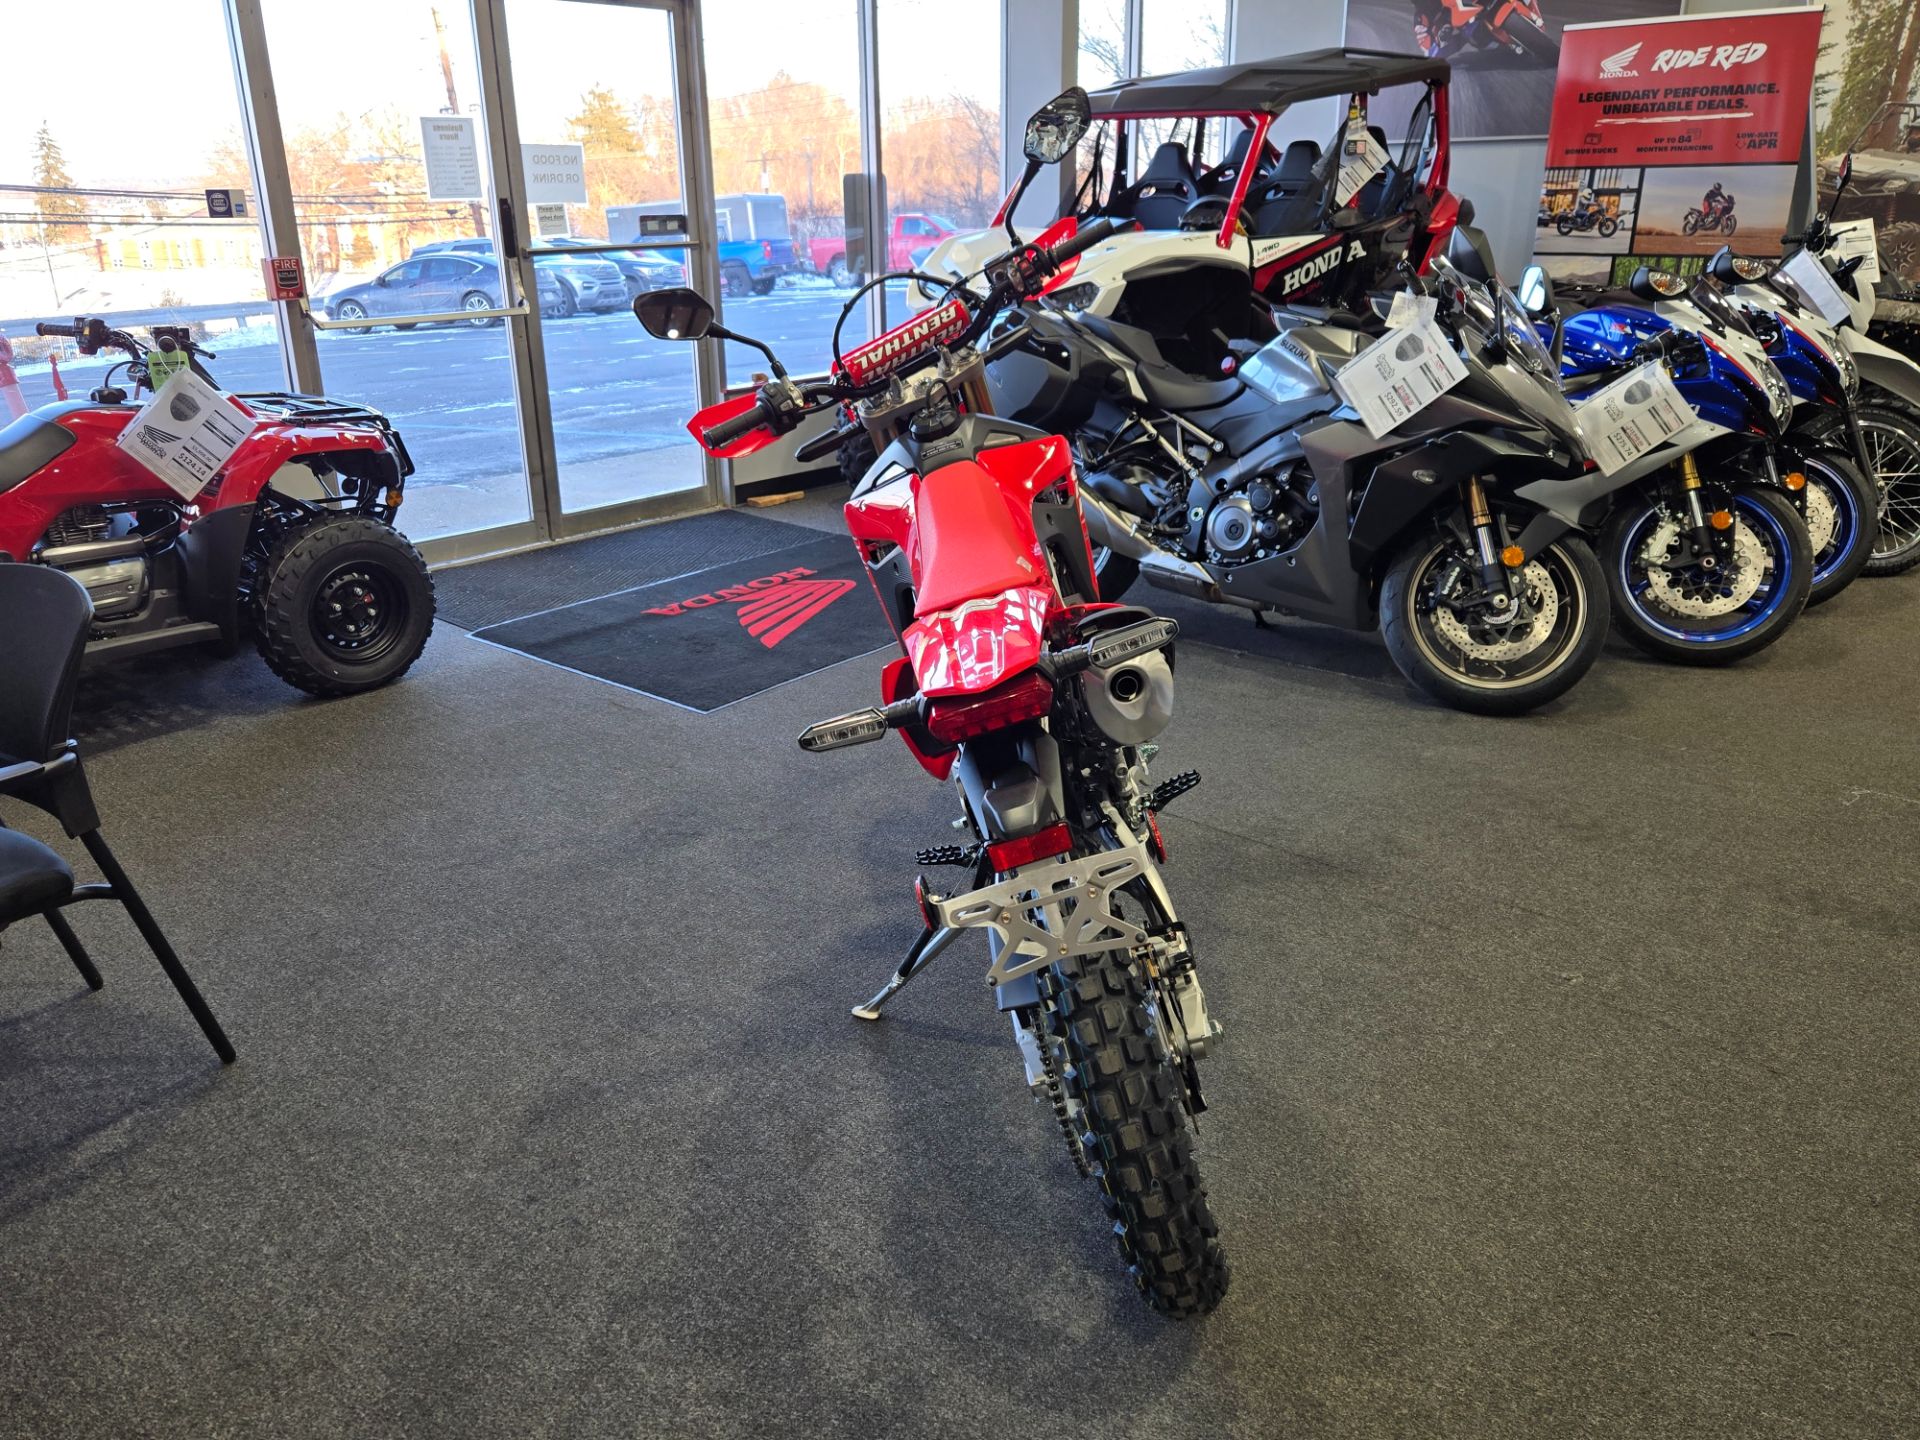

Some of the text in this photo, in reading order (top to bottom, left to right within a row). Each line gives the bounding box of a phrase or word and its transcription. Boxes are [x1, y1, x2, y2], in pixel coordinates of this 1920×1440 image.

[1651, 42, 1768, 74] RIDE RED
[1599, 70, 1639, 79] HONDA
[1578, 82, 1780, 103] LEGENDARY PERFORMANCE.
[1602, 98, 1749, 115] UNBEATABLE DEALS.
[1677, 135, 1692, 144] 84
[1746, 138, 1778, 150] APR
[273, 259, 297, 269] FIRE
[1281, 239, 1367, 296] HONDA
[854, 305, 957, 370] RENTHAL
[1279, 338, 1310, 362] SUZUKI
[1384, 391, 1404, 417] $292.59
[1613, 432, 1634, 457] $275.74
[178, 452, 207, 476] $124.14
[640, 566, 818, 617] HONDA
